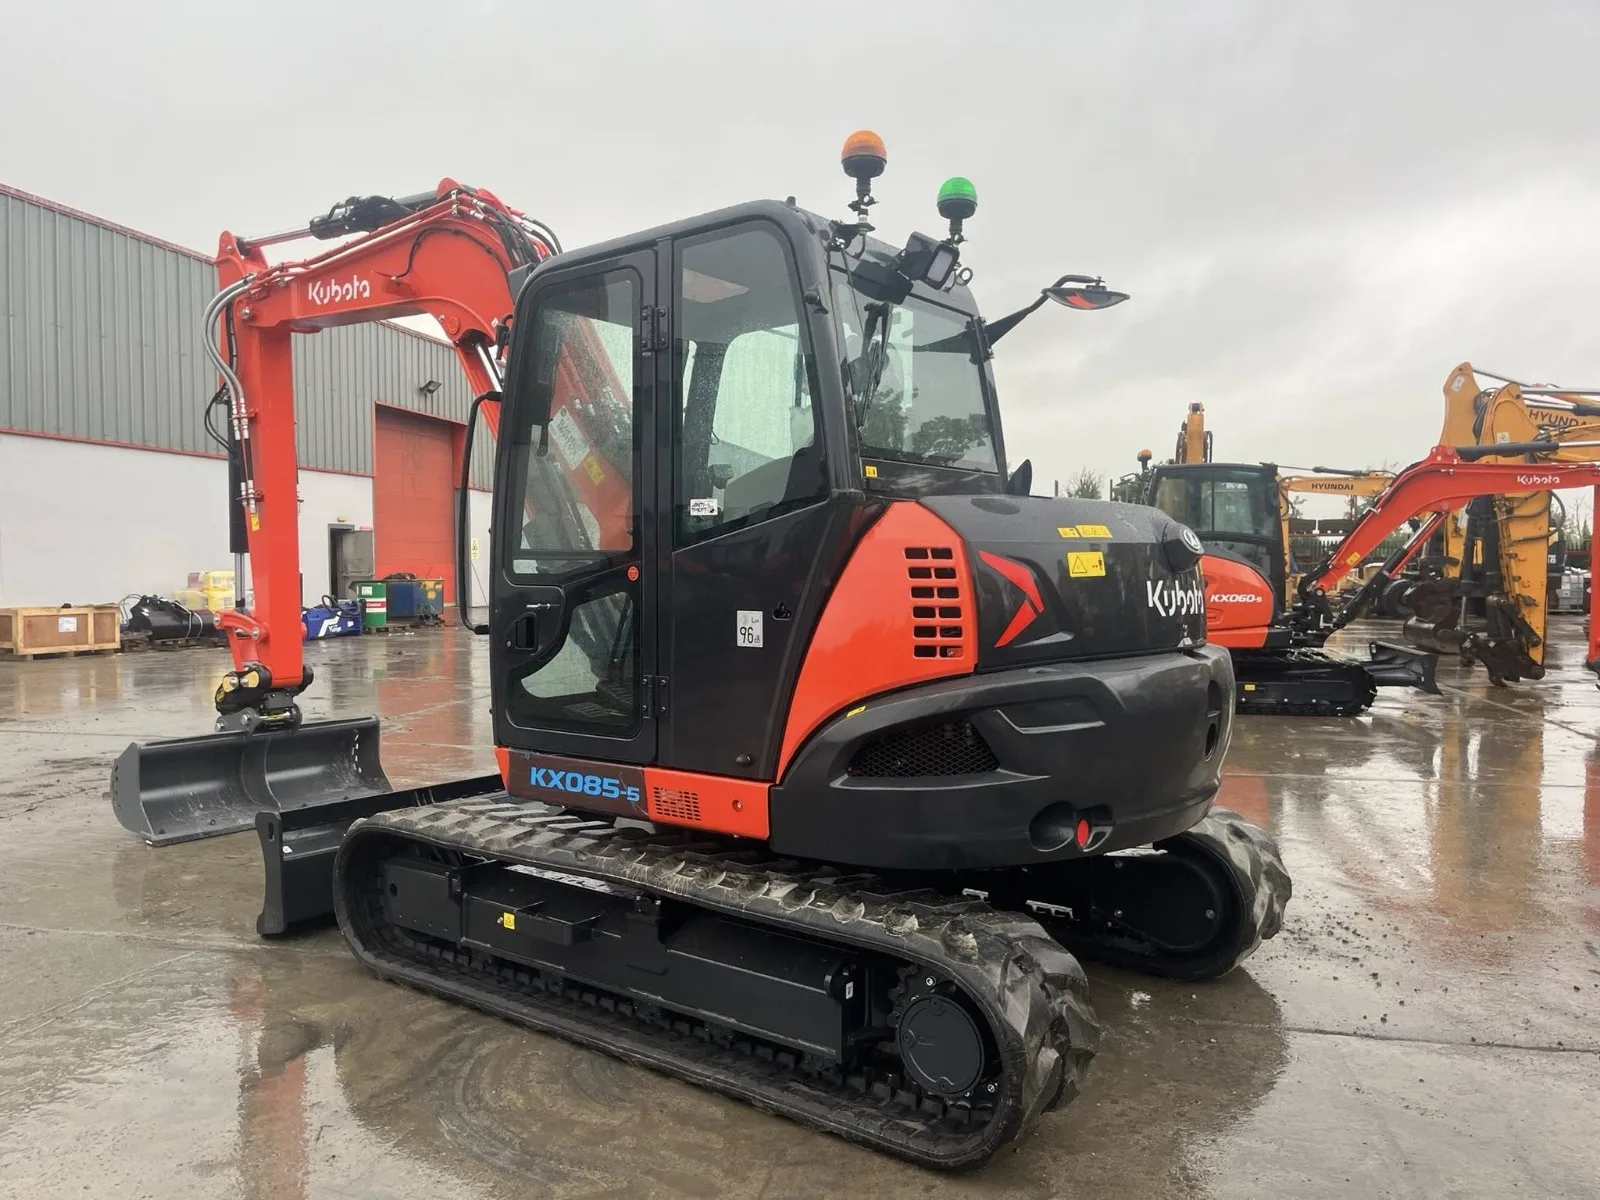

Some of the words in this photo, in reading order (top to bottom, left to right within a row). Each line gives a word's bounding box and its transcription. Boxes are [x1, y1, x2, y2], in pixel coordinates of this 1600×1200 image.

[308, 274, 371, 306] Kubota
[1311, 483, 1354, 491] HYUNDAI
[1517, 475, 1560, 485] Kubota
[1146, 580, 1204, 617] Kubota
[740, 626, 754, 644] 96
[530, 767, 640, 802] KX085-5
